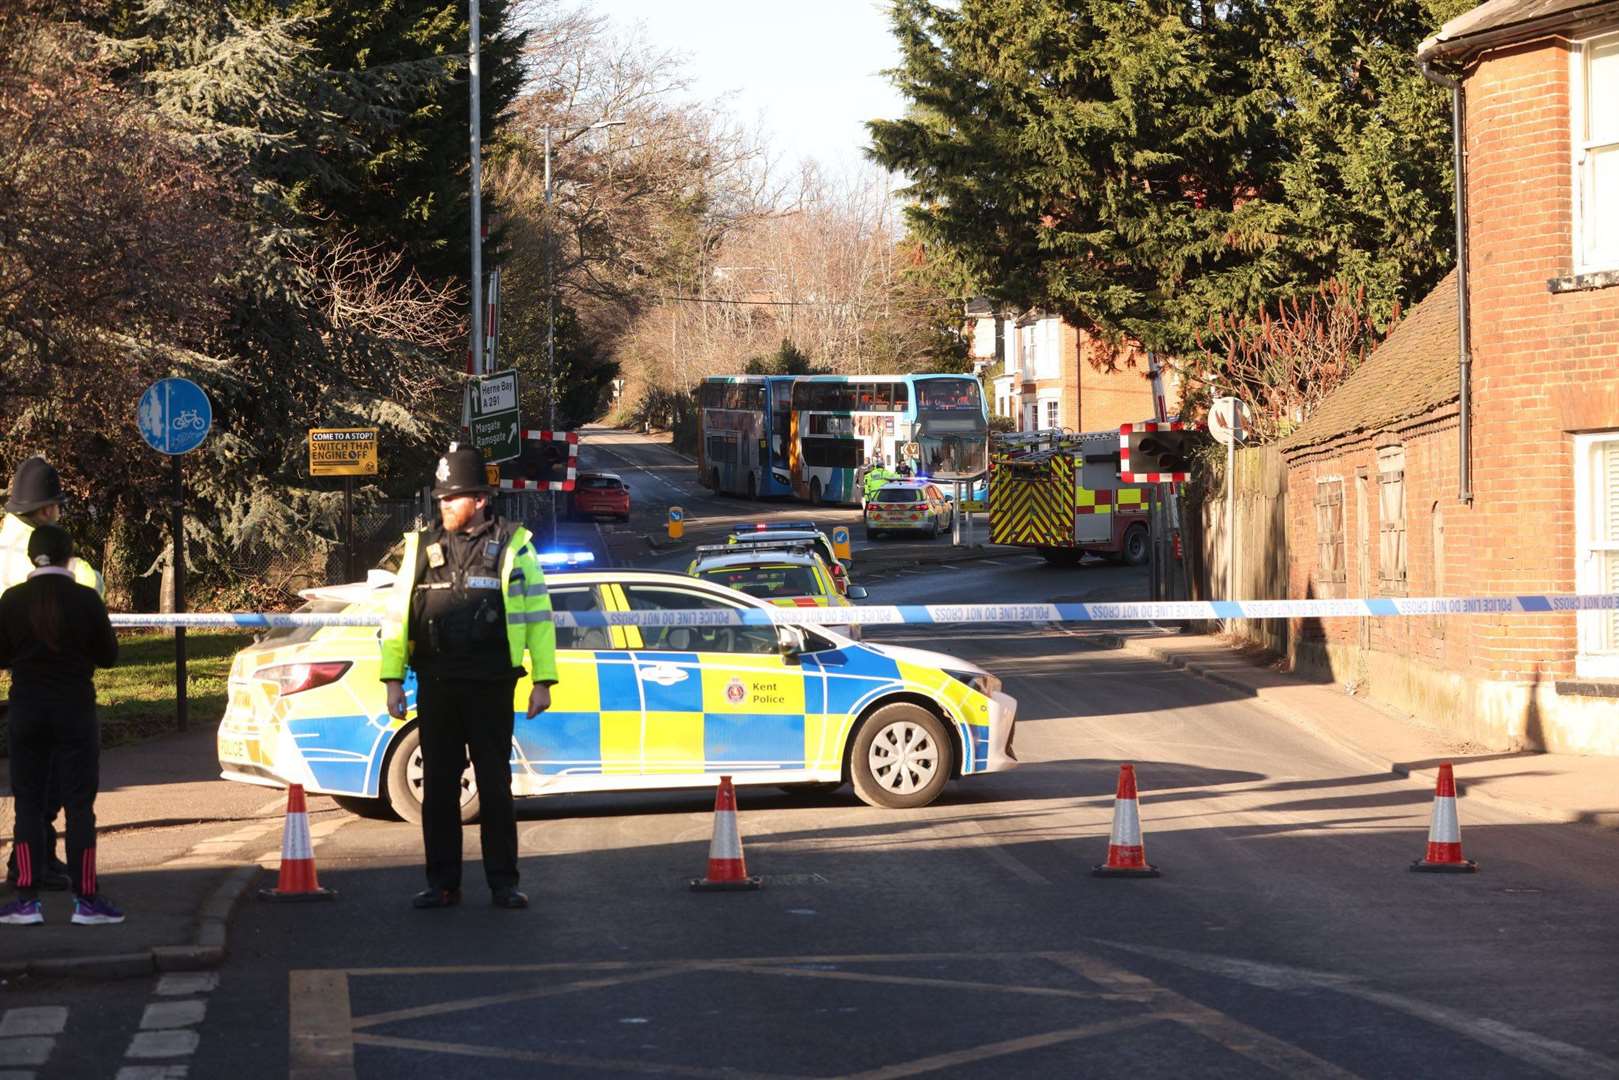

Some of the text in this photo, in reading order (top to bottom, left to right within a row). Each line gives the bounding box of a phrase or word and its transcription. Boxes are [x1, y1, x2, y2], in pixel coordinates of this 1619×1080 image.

[482, 380, 513, 395] Herne Bay
[475, 420, 500, 433] Margate
[352, 432, 373, 440] STOP?
[477, 432, 506, 447] Ramsgate
[312, 442, 374, 451] SWITCH THAT
[312, 450, 368, 460] ENGINE OFF
[1400, 599, 1512, 614] POLICE LINE DO NOT CROSS
[1553, 597, 1581, 610] CROSS
[1583, 596, 1599, 610] NOT
[1601, 596, 1613, 609] DO
[611, 611, 730, 625] POLICE LINE DO NOT CROSS
[774, 609, 892, 624] POLICE LINE DO NOT CROSS
[934, 606, 1049, 621] POLICE LINE DO NOT CROSS
[1092, 604, 1205, 619] POLICE LINE DO NOT CROSS
[752, 682, 777, 691] Kent
[752, 695, 785, 703] Police
